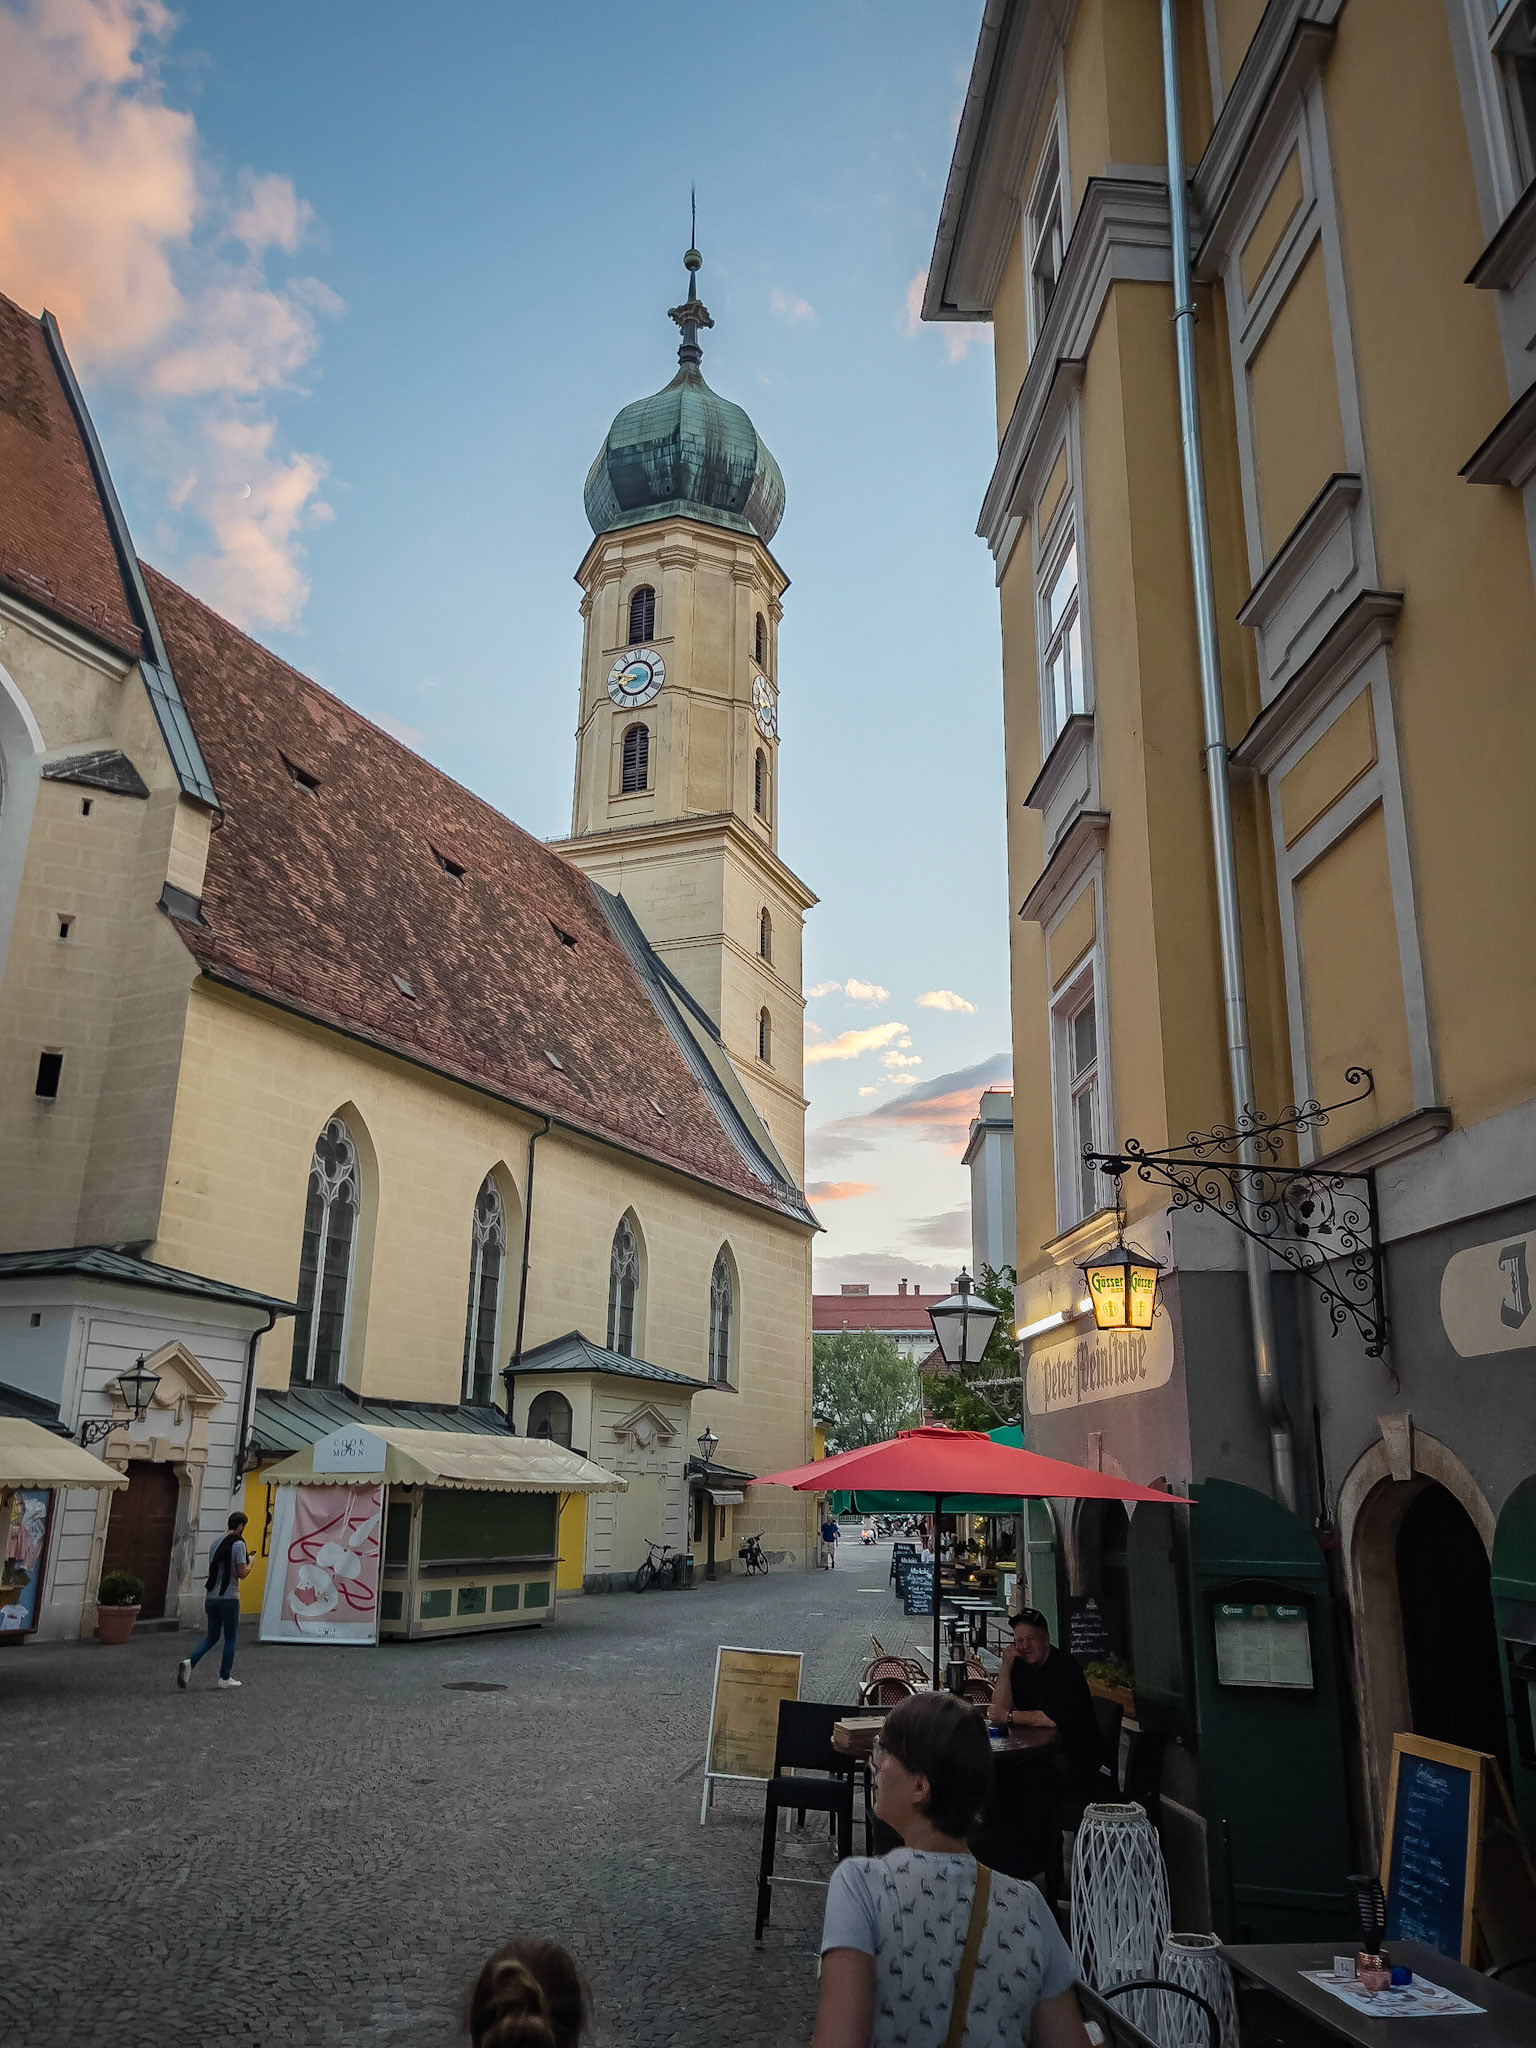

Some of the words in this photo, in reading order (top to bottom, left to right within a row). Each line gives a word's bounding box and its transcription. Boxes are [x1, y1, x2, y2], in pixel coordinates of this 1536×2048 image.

[1092, 1272, 1124, 1294] Gösser
[1130, 1271, 1154, 1293] Gösser
[334, 1438, 365, 1447] COOK
[333, 1448, 364, 1457] MOON
